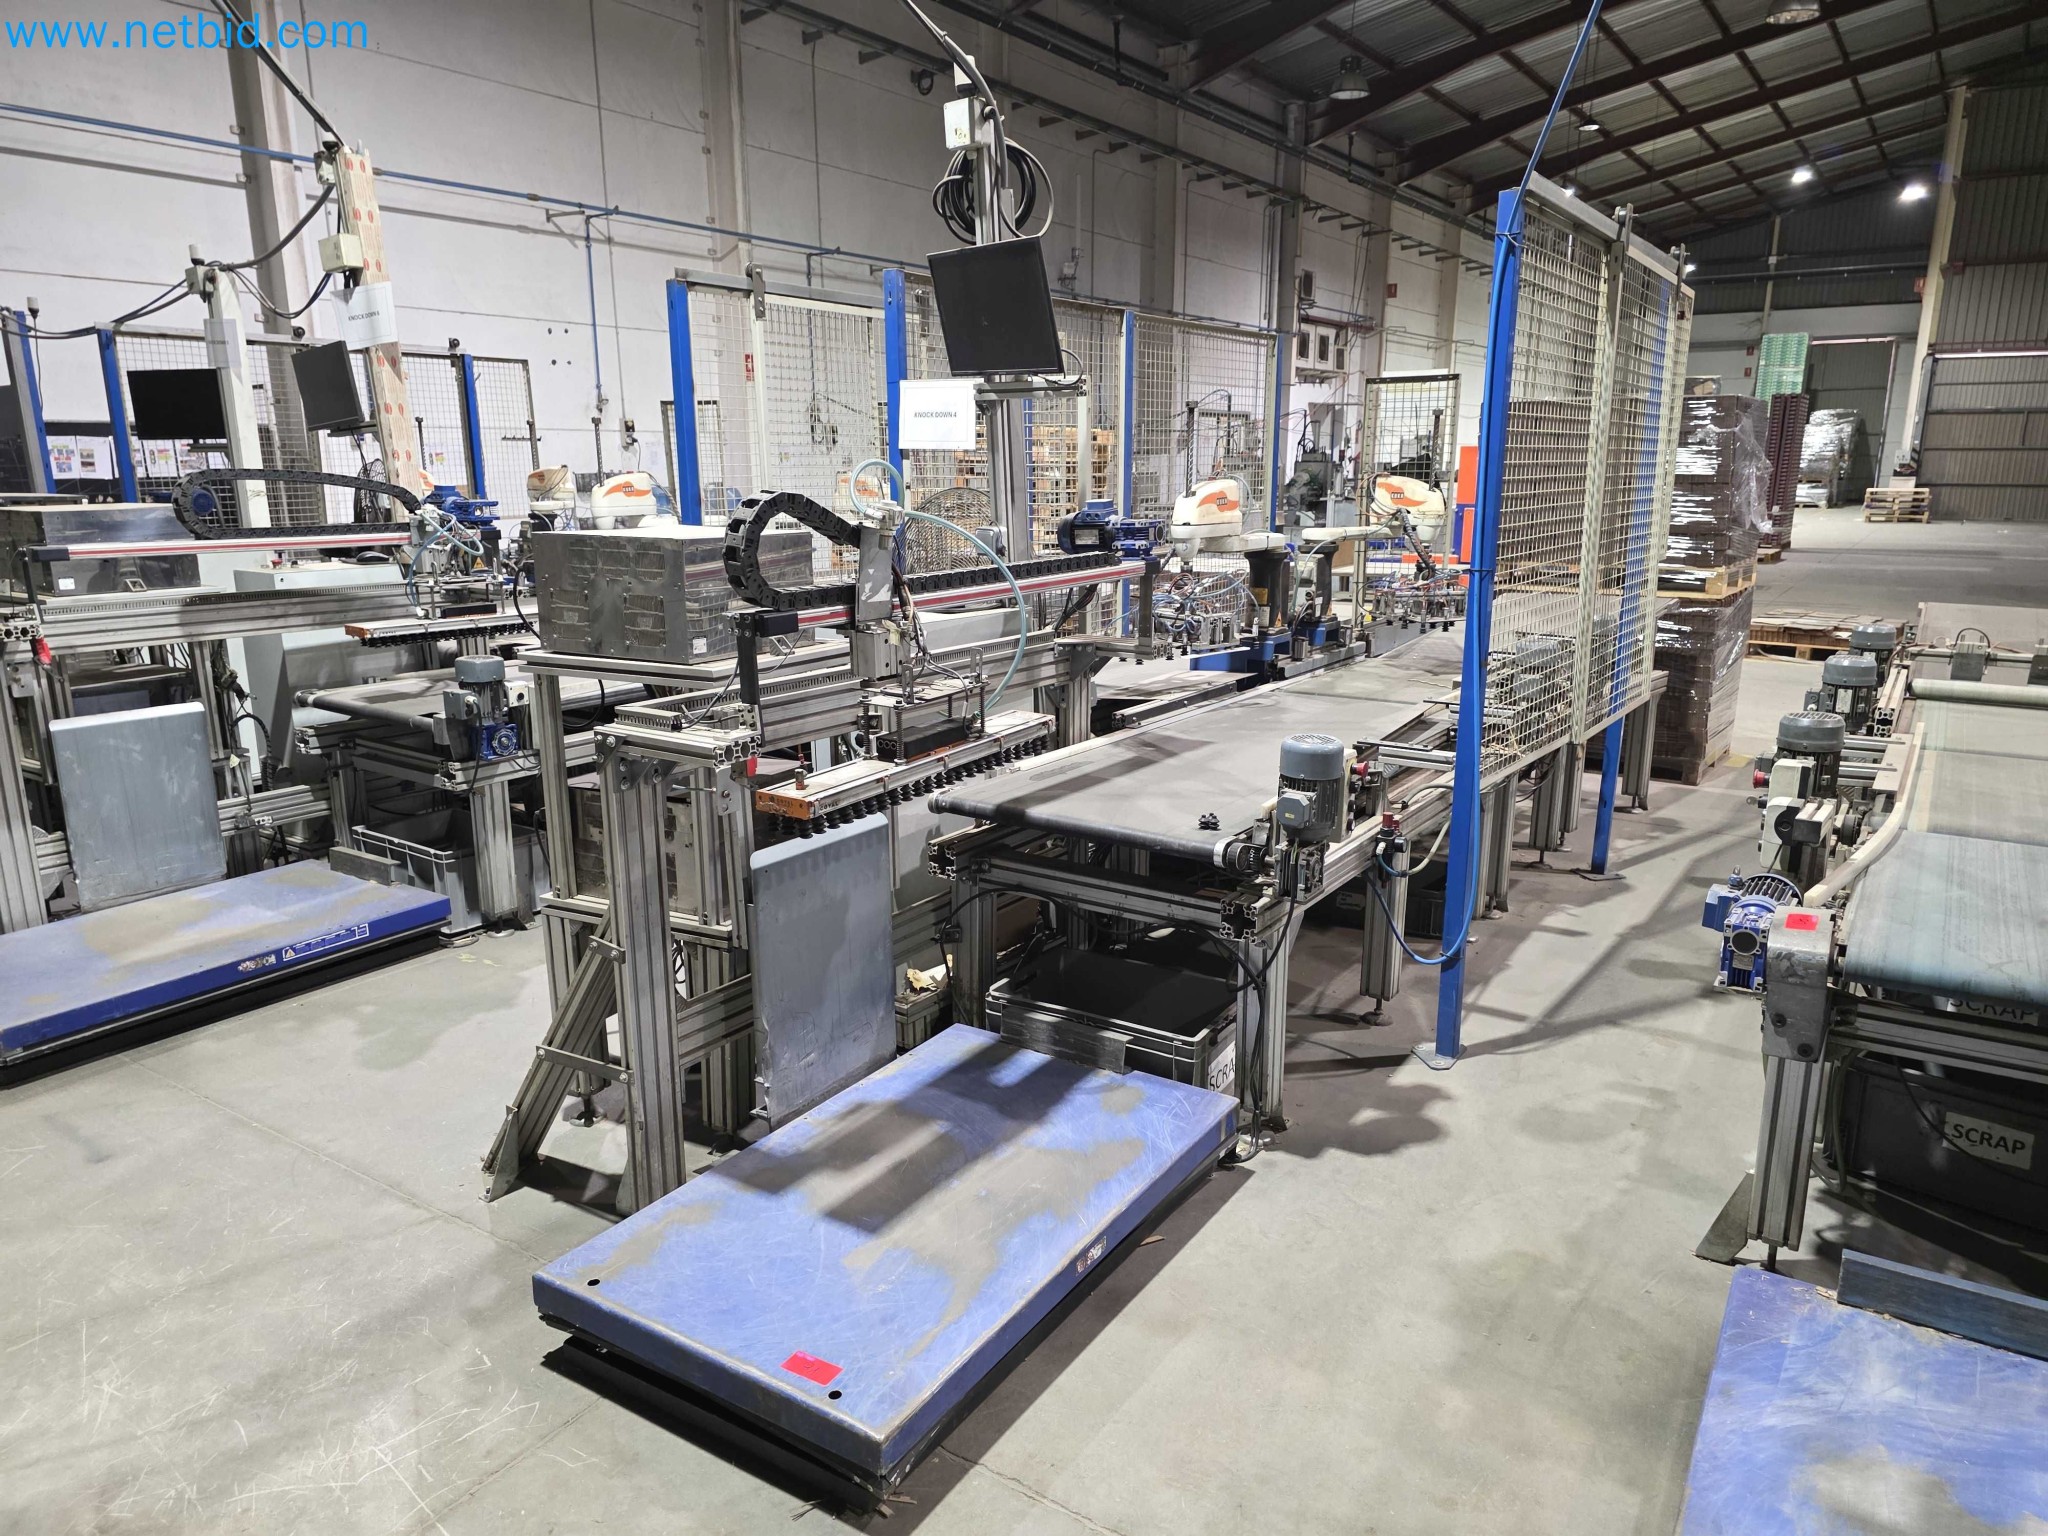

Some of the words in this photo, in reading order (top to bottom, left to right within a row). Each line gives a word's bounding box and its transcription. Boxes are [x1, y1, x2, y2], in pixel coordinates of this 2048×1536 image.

[348, 313, 365, 321] KNOCK
[1209, 1057, 1235, 1092] SCRA
[1951, 1123, 2026, 1155] SCRAP
